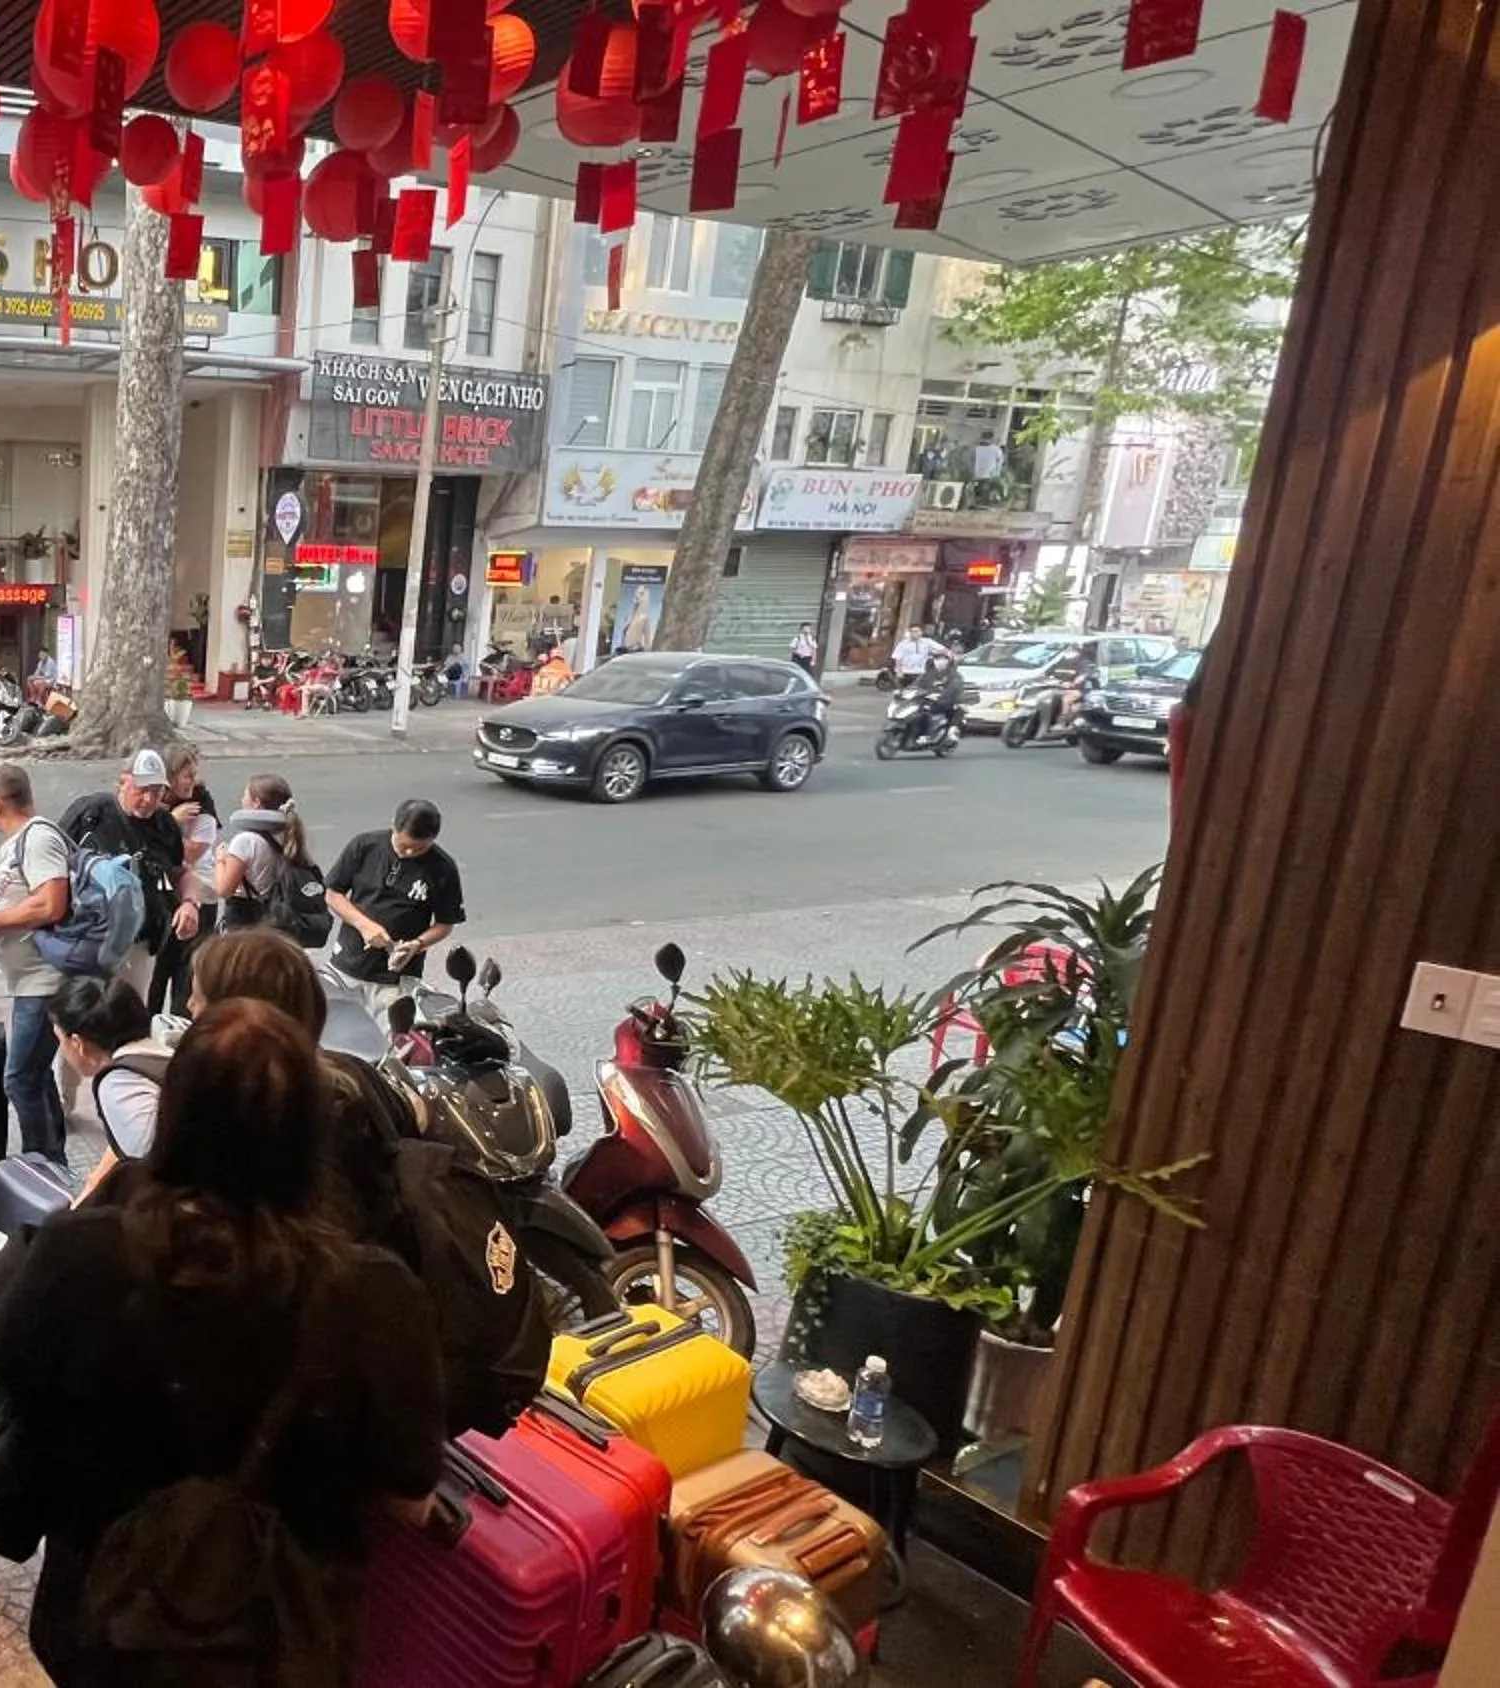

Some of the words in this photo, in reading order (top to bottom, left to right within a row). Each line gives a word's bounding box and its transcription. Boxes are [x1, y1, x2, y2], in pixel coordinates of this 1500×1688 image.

[319, 356, 380, 381] KHÁCH
[386, 365, 417, 387] SẠN
[333, 380, 362, 403] SÀI
[365, 387, 400, 408] GÒN
[417, 372, 460, 402] VÊN
[351, 407, 429, 439] LITTL
